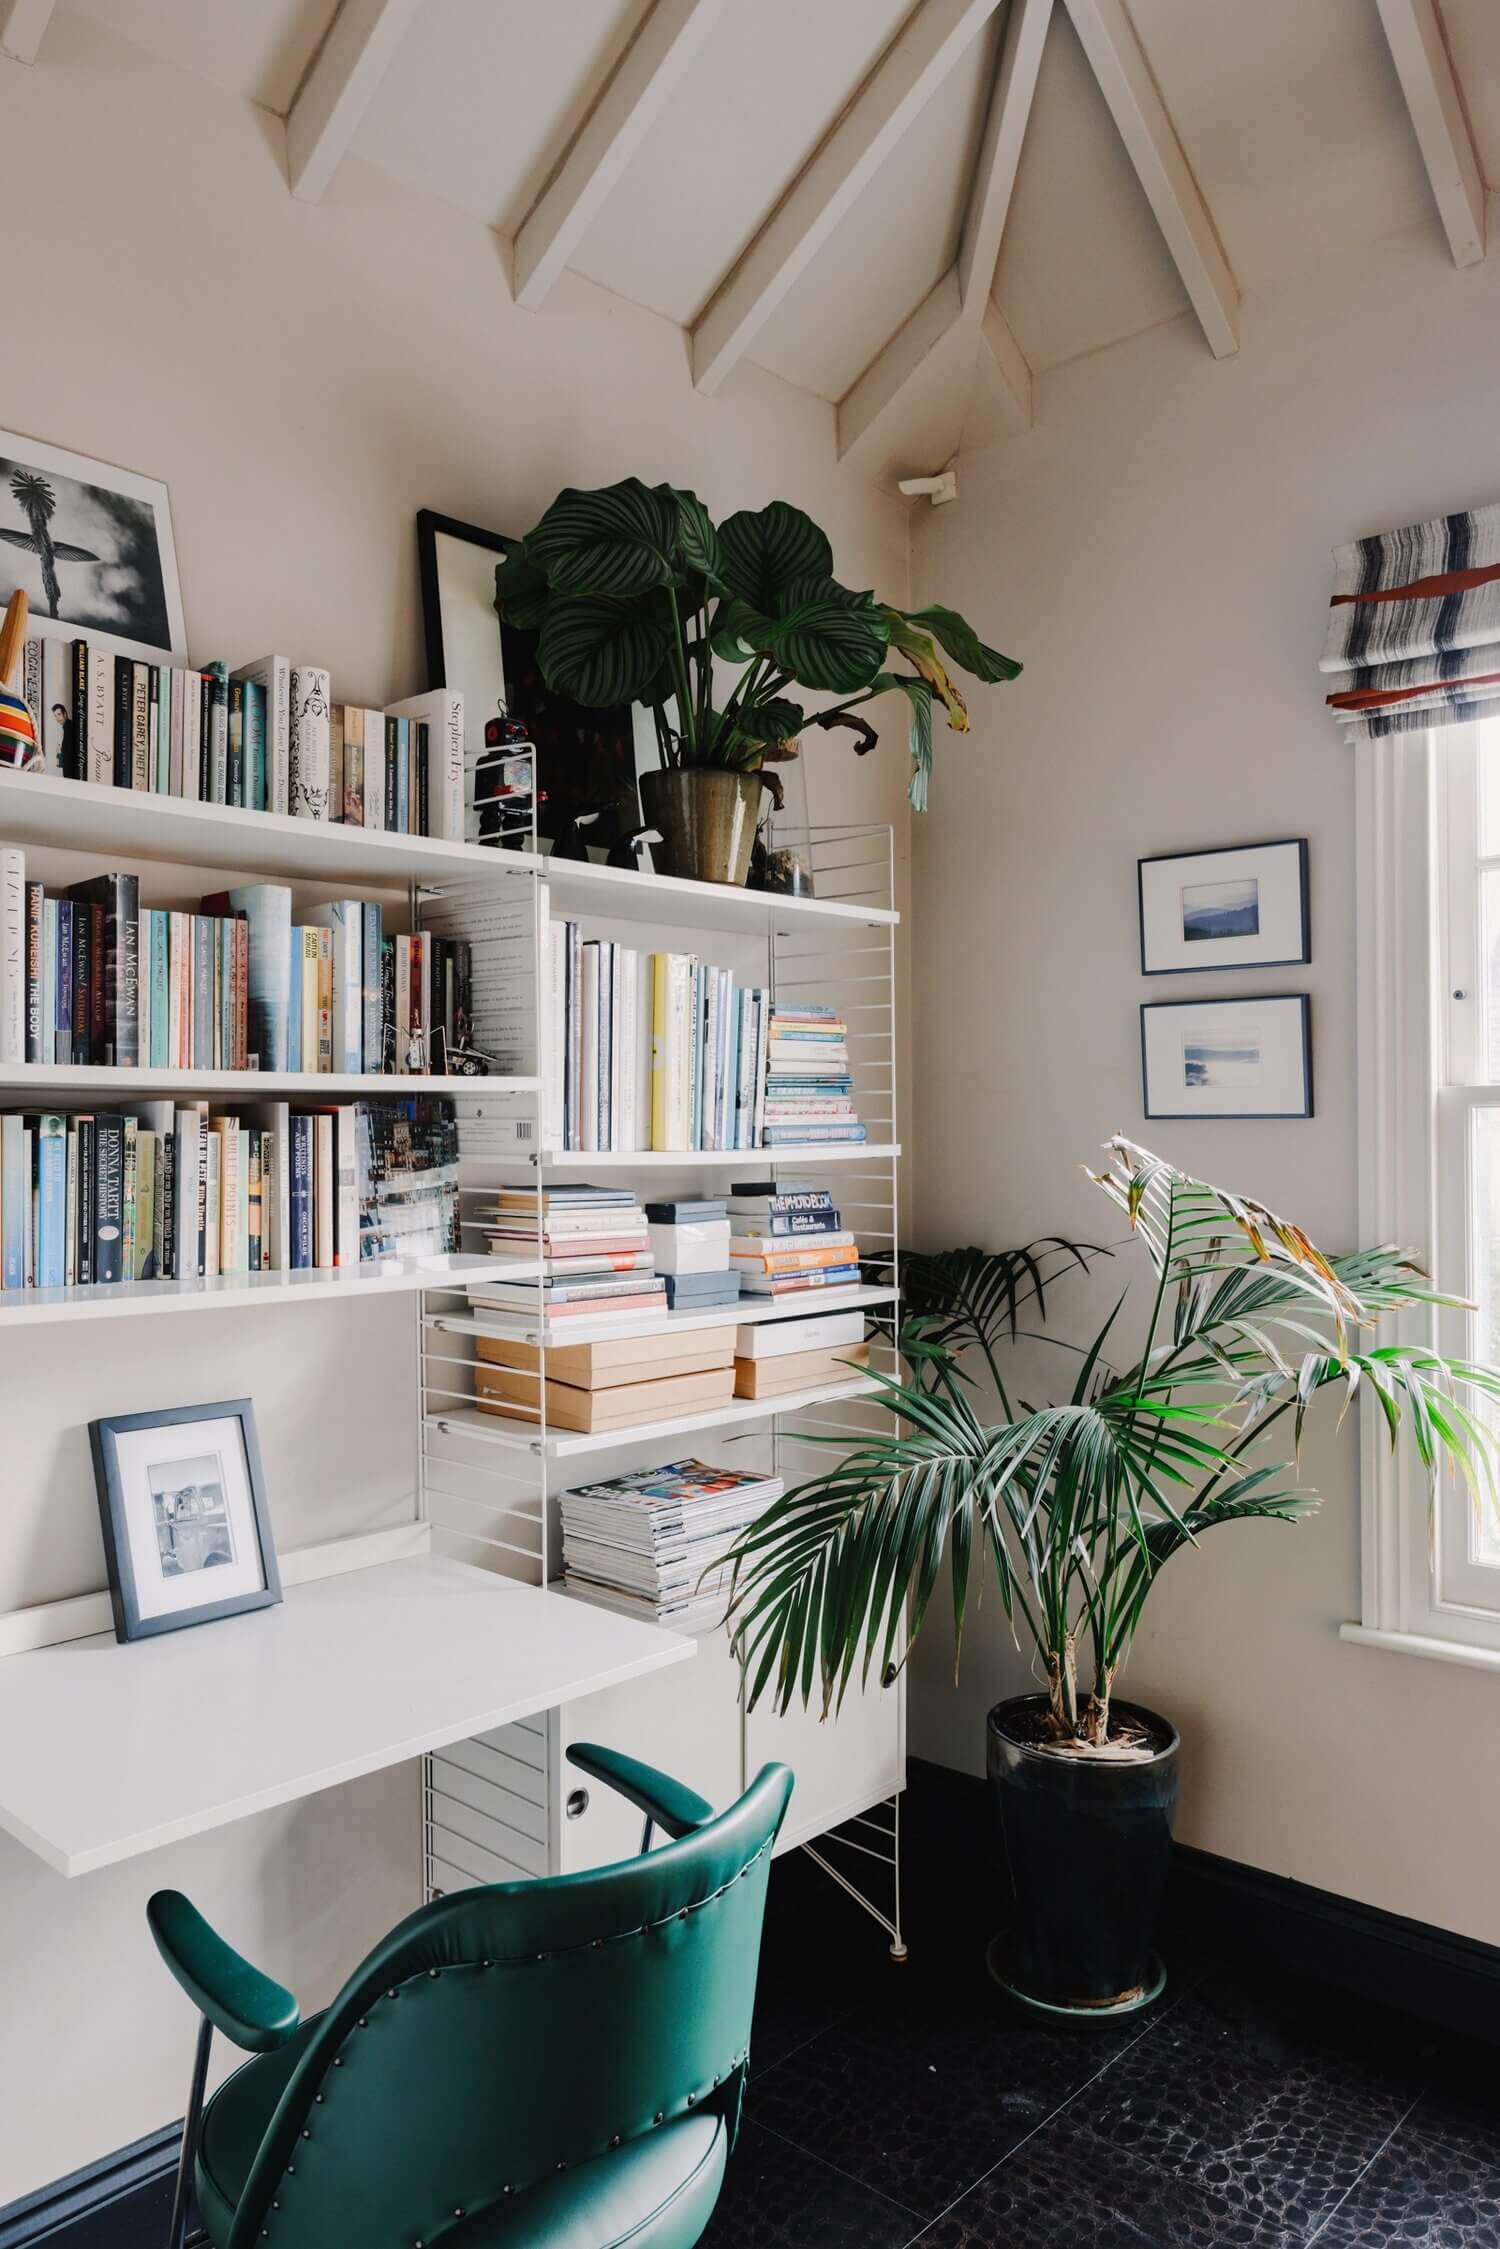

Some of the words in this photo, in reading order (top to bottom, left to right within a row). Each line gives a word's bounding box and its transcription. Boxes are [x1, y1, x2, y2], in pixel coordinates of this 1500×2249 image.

[96, 686, 104, 728] BYATT
[137, 683, 146, 713] PETER
[135, 715, 146, 748] CAREY,
[448, 702, 461, 757] Stephen
[136, 749, 146, 778] THEFT
[448, 762, 461, 784] Fry
[30, 886, 40, 920] HANIF
[30, 924, 40, 979] KUREISHI
[30, 982, 40, 1004] THE
[30, 1008, 40, 1040] BODY
[98, 1128, 107, 1147] THE
[108, 1130, 118, 1176] DONNA
[98, 1149, 107, 1182] SECRET
[227, 1135, 237, 1177] BULLET
[98, 1183, 107, 1220] HISTORY
[108, 1177, 118, 1220] TARTT
[227, 1184, 237, 1226] POINTS
